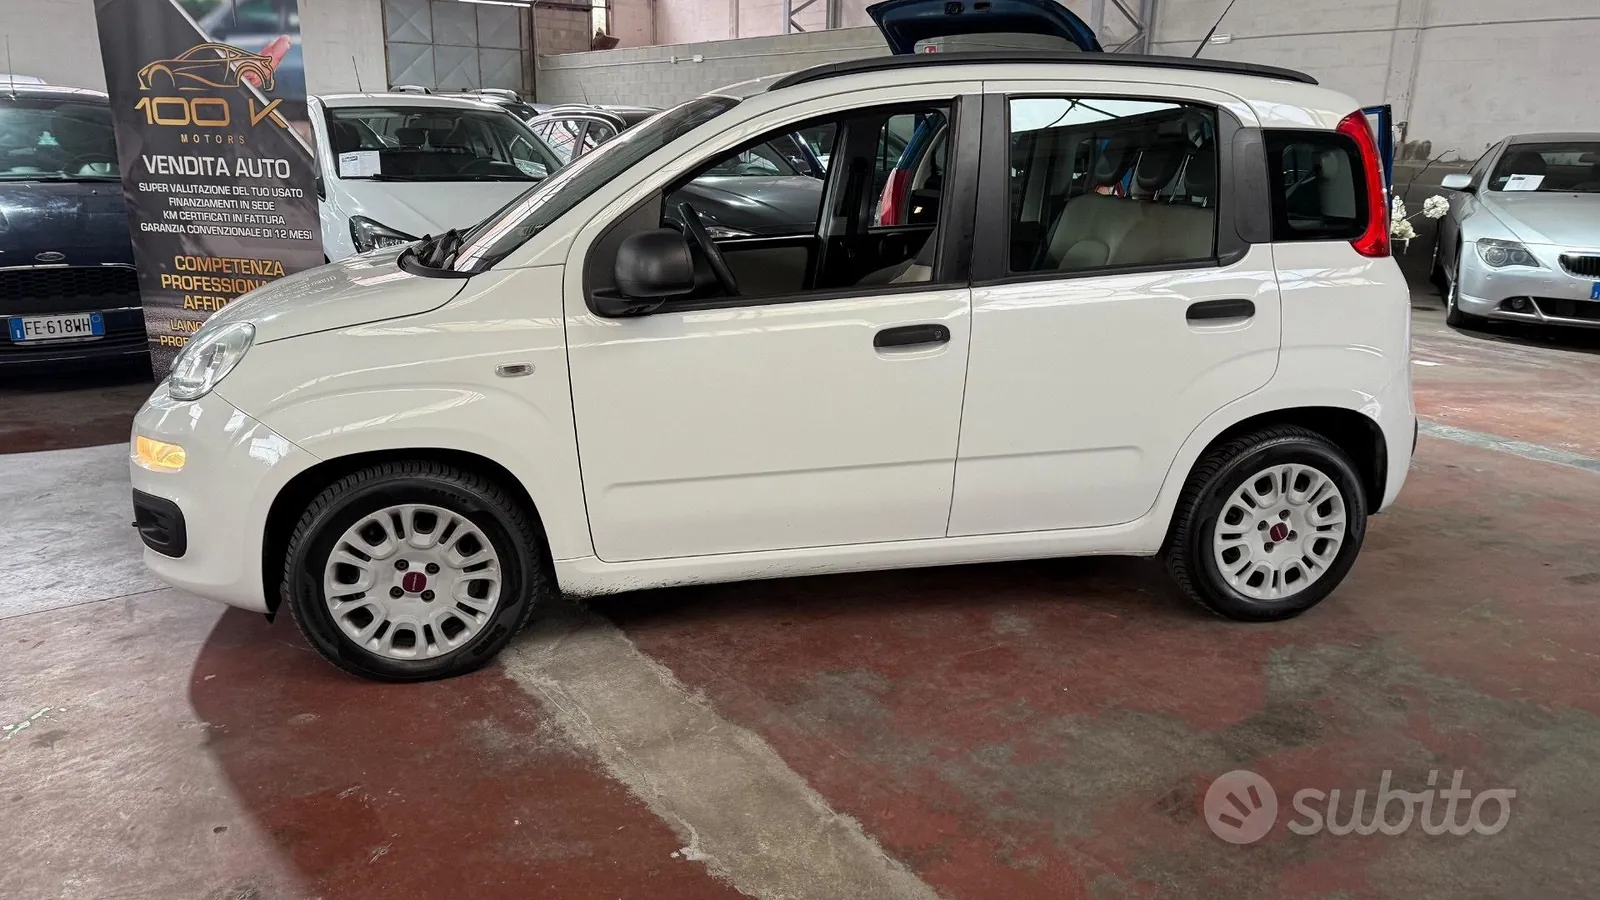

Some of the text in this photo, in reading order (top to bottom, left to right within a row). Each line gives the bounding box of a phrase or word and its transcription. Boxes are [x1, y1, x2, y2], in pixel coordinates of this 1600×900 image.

[134, 96, 289, 129] 100 K
[181, 133, 246, 145] MOTORS
[142, 154, 291, 179] VENDITA AUTO
[138, 182, 303, 198] SUPER VALUTAZIONE DEL TUO USATO
[169, 197, 275, 211] FINANZIAMENTI IN SEDE
[163, 210, 285, 225] KM CERTIFICATI IN FATTURA
[140, 222, 313, 240] GARANZIA CONVENZIONALE DI 12 MESI
[174, 255, 286, 277] COMPETENZA
[183, 294, 234, 311] AFFID
[170, 319, 204, 333] LA NO
[159, 335, 190, 347] PROF
